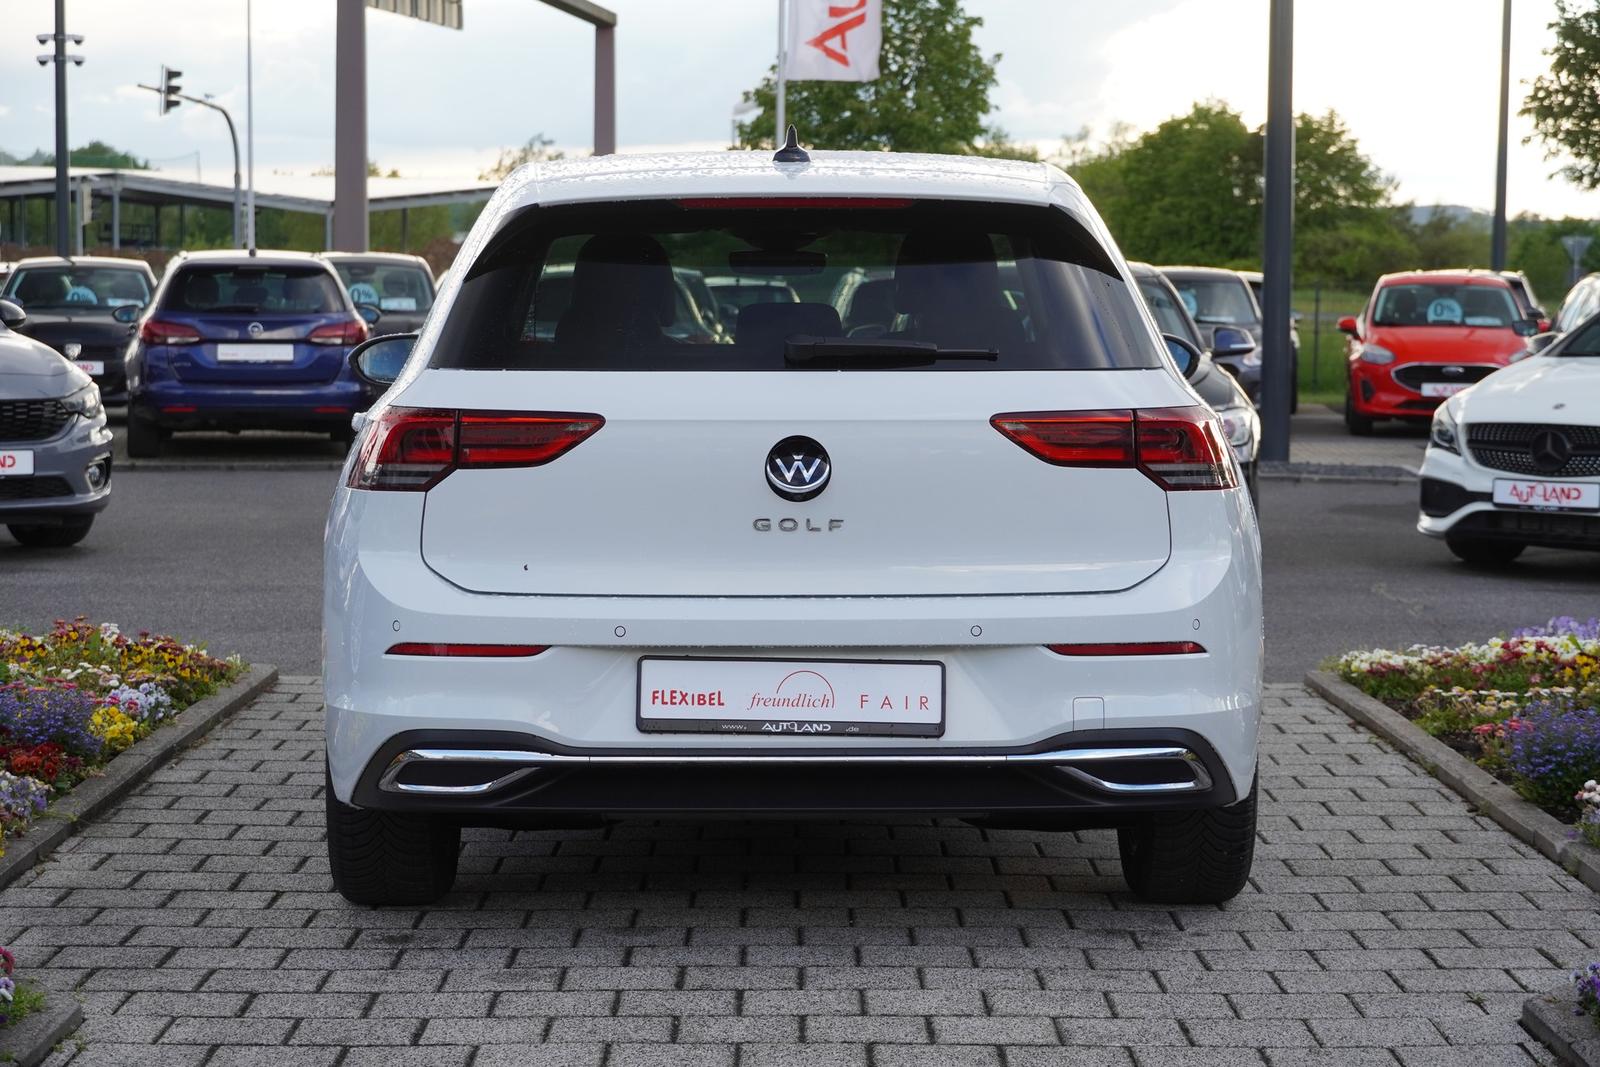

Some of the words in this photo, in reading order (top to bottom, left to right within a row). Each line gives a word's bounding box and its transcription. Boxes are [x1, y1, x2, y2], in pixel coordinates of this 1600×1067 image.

[1510, 481, 1582, 504] AUTOLAND
[752, 517, 844, 532] GOLF
[651, 689, 725, 707] FLEXIBEL
[746, 692, 830, 711] freundlich
[859, 694, 930, 711] FAIR
[761, 721, 832, 733] AUTOLAND
